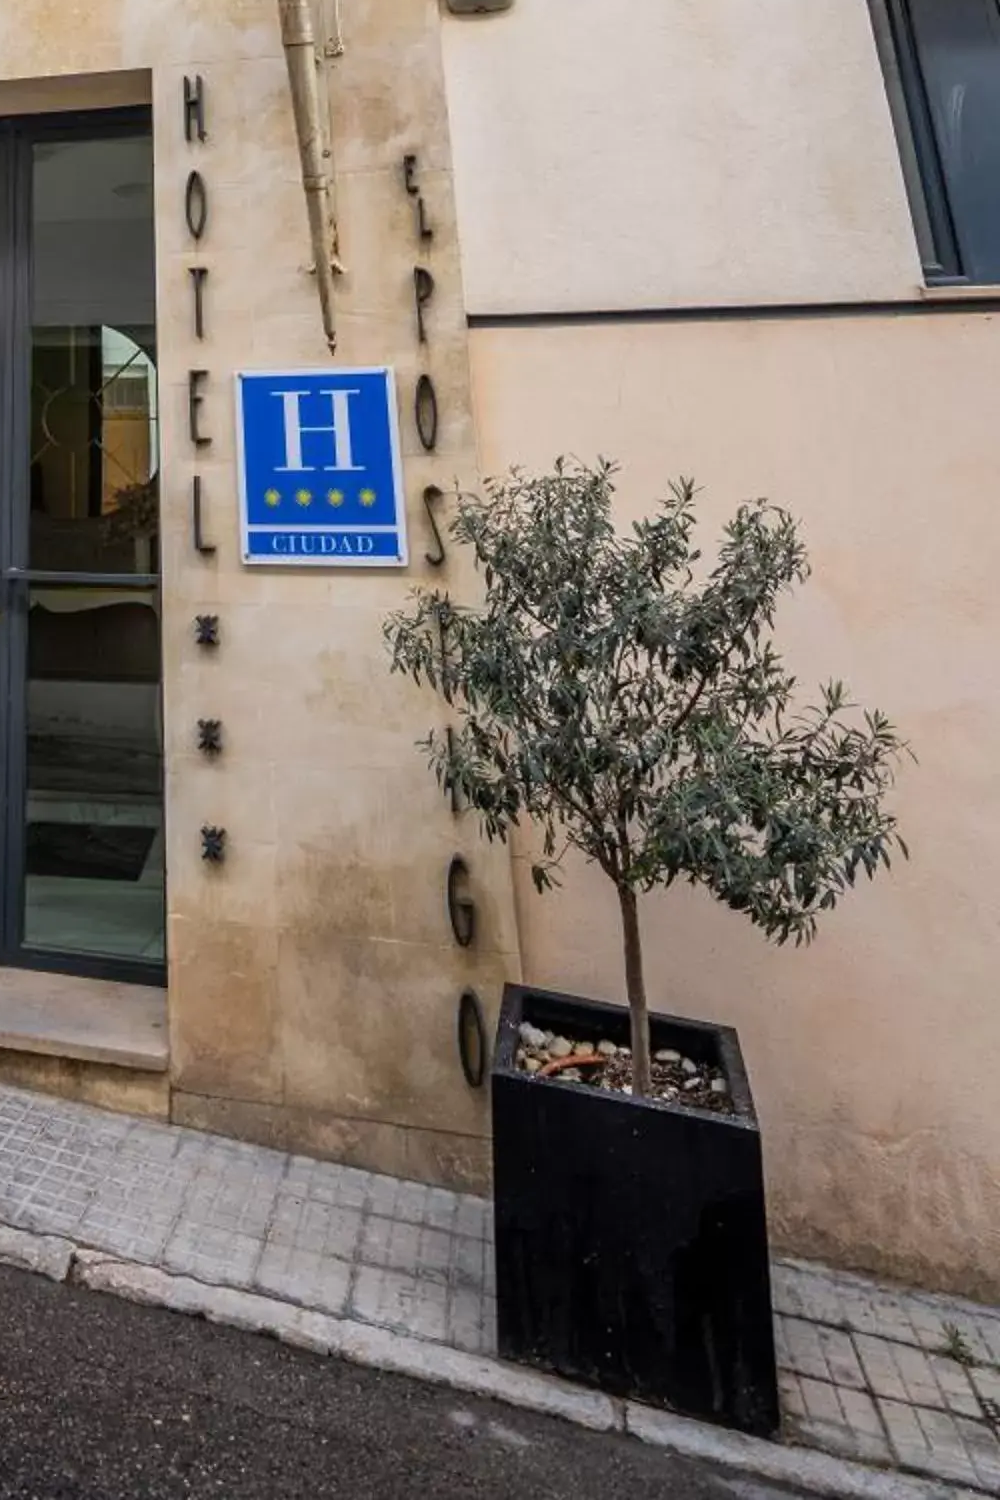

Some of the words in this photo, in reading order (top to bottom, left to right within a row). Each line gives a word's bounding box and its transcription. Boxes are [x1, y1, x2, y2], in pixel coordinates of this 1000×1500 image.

[403, 155, 433, 240] EL
[183, 74, 217, 553] HOTEL
[269, 389, 367, 472] H
[271, 534, 374, 554] CIUDAD
